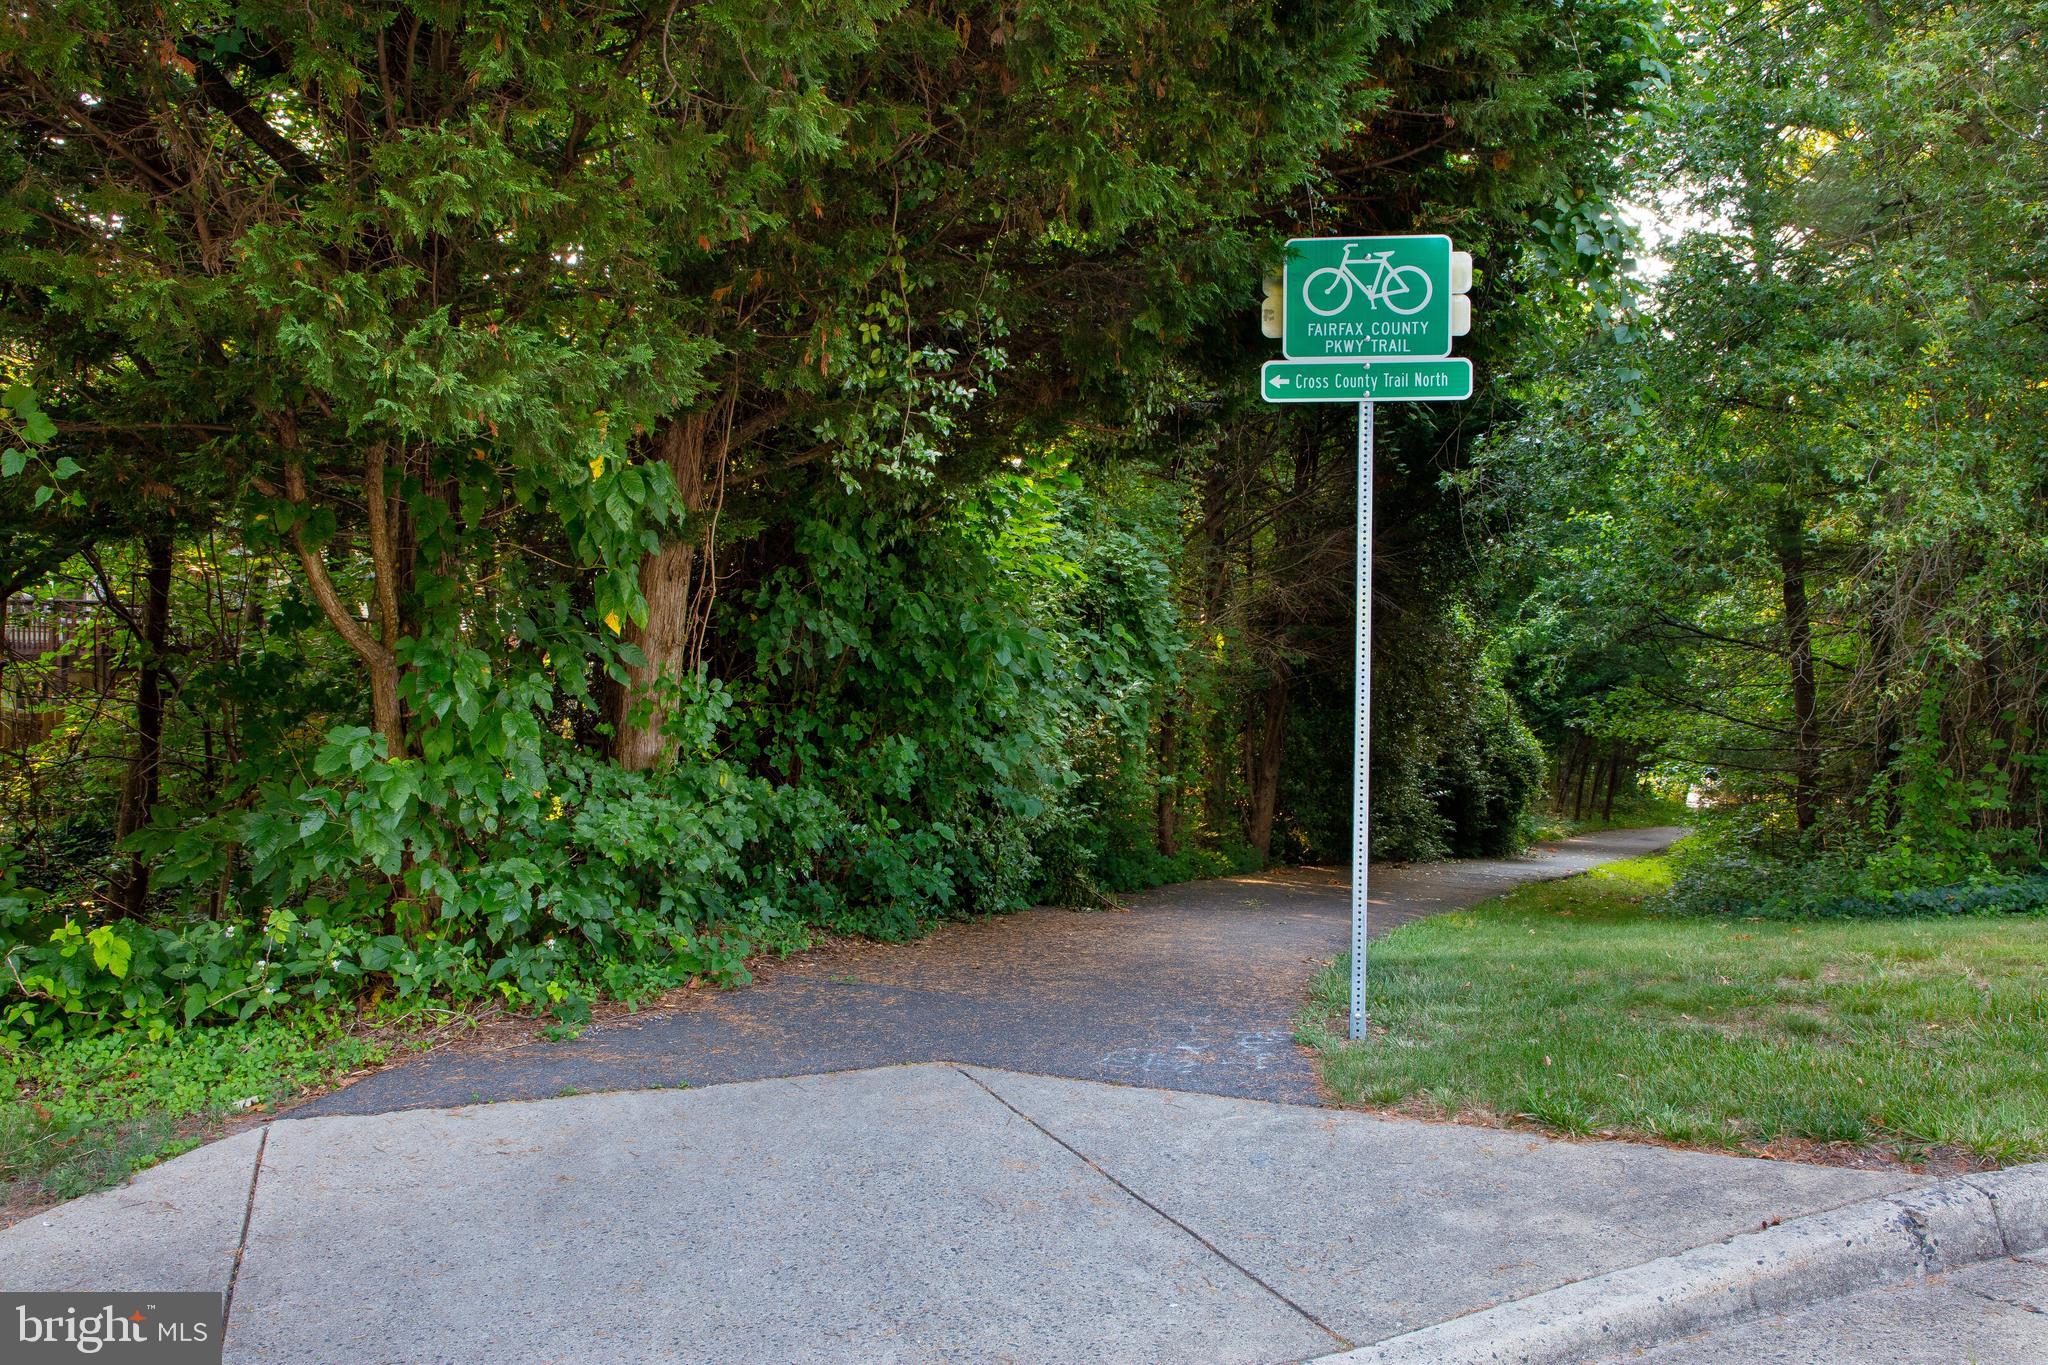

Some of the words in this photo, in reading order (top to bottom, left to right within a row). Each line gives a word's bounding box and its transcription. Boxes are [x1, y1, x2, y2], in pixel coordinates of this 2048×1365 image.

[1308, 323, 1363, 336] FAIRFAX
[1372, 322, 1429, 334] COUNTY
[1325, 340, 1364, 353] PKWY
[1371, 339, 1411, 352] TRAIL
[1295, 374, 1329, 389] Cross
[1335, 373, 1378, 391] County
[1384, 373, 1409, 387] Trail
[1414, 372, 1449, 387] North
